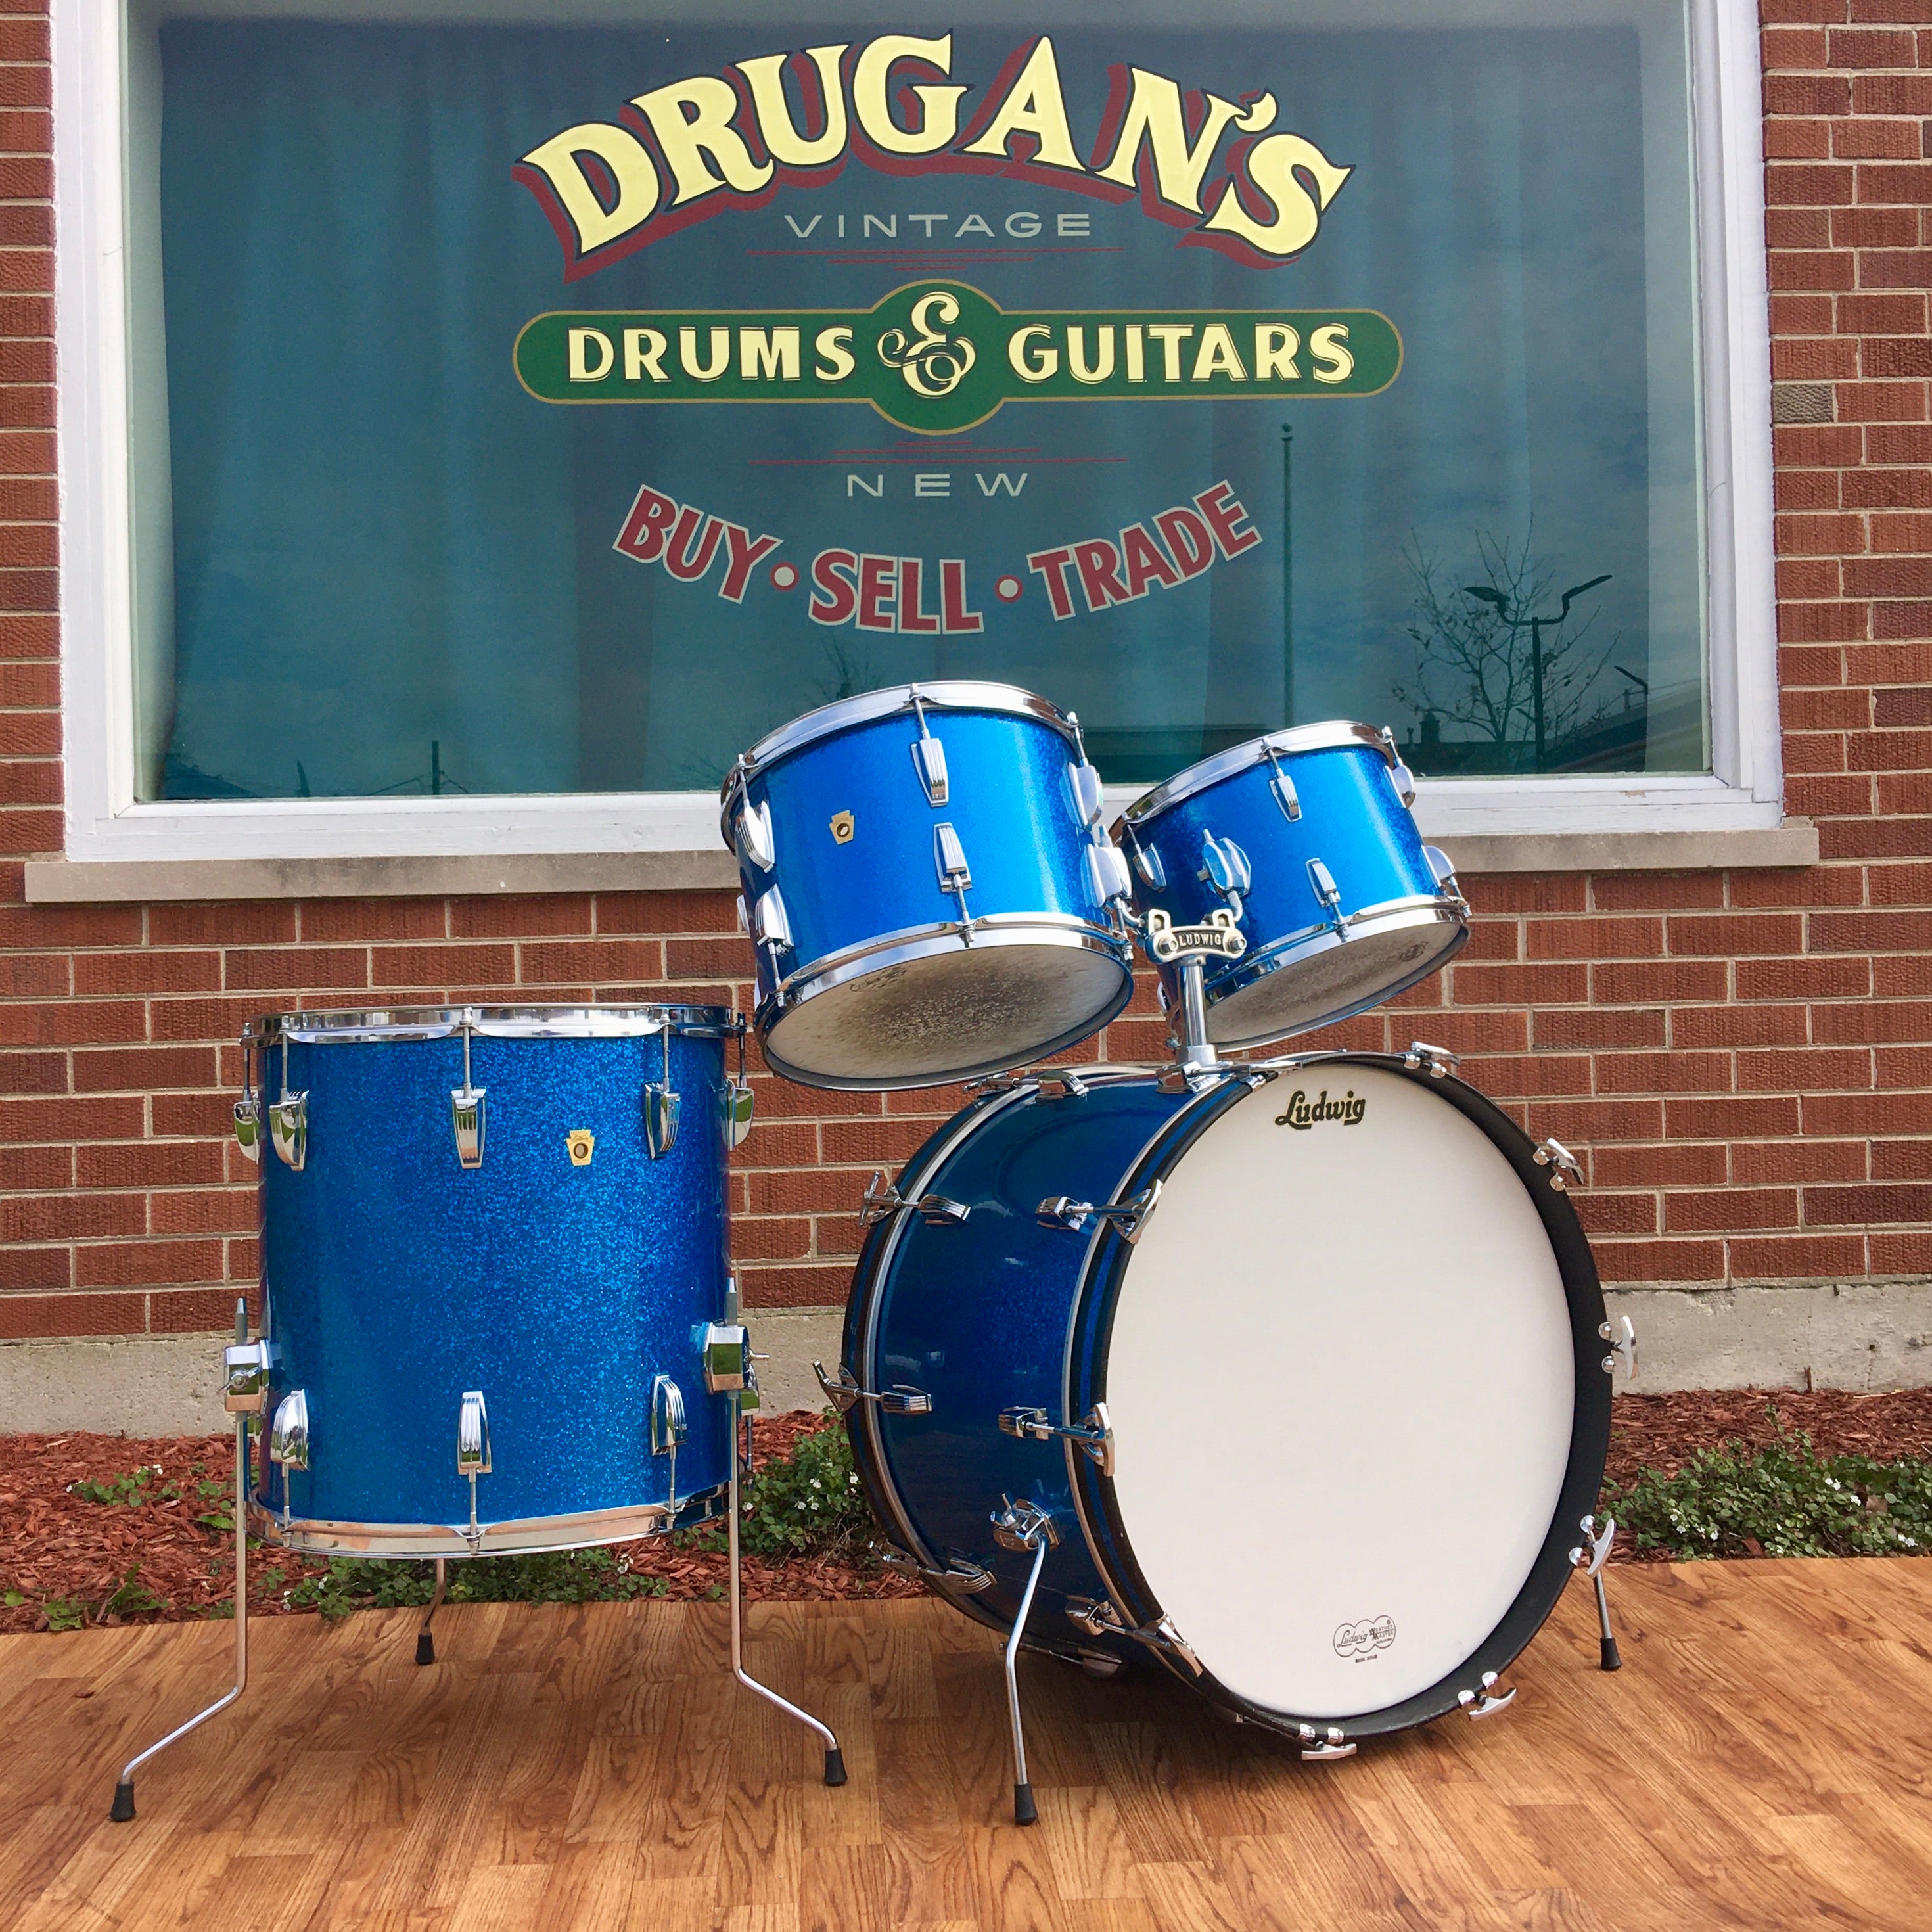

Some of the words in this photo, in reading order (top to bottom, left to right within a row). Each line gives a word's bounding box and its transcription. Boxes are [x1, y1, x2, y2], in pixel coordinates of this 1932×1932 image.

[519, 30, 1355, 258] DRUGAN'S
[783, 212, 1091, 238] VINTAGE
[566, 326, 856, 382] DRUMS
[877, 291, 976, 398] &
[1007, 323, 1355, 384] GUITARS
[846, 473, 1029, 497] NEW
[611, 483, 783, 605] BUY
[808, 548, 984, 635] SELL
[1026, 480, 1263, 621] TRADE
[1178, 933, 1222, 946] LUDWIG
[1274, 1090, 1366, 1130] Ludwig
[1337, 1629, 1368, 1648] Ludwig
